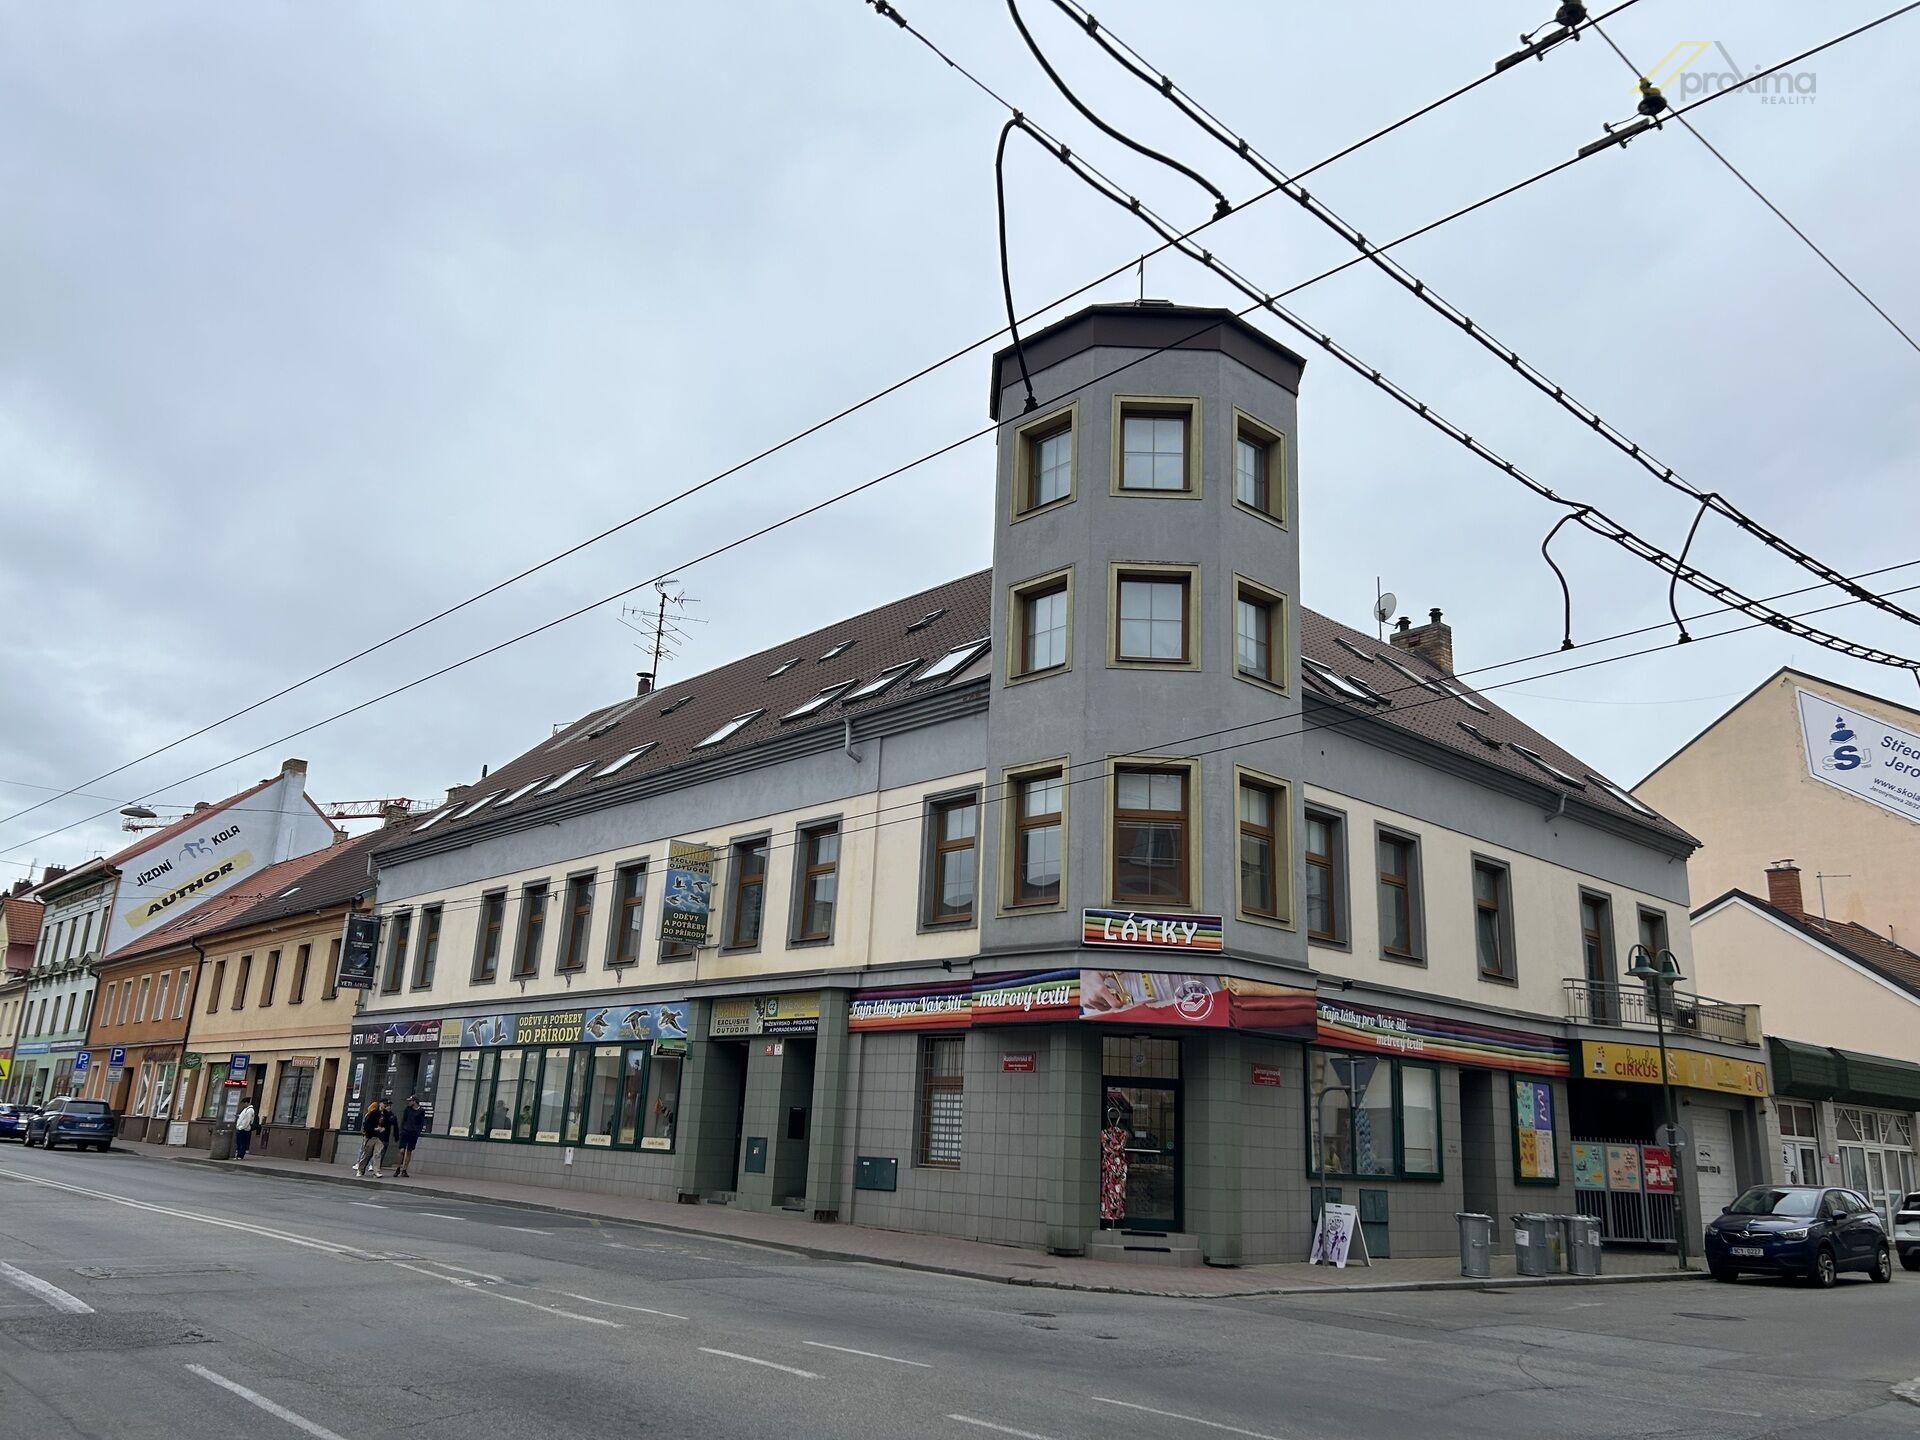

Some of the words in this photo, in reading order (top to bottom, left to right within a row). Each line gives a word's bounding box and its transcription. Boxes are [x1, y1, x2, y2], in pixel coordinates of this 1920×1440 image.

[137, 858, 173, 886] JÍZDNÍ
[212, 825, 240, 846] KOLA
[670, 857, 710, 868] EXCLUSIVE
[670, 863, 710, 874] OUTDOOR
[147, 862, 234, 916] AUTHOR
[673, 912, 699, 922] ODĚVY
[672, 920, 706, 930] POTŘEBY
[1104, 912, 1198, 944] LÁTKY
[676, 928, 706, 938] PŘÍRODY
[979, 987, 1034, 1012] metrový
[1036, 986, 1070, 1005] textil
[852, 1002, 872, 1020] Fajn
[873, 1000, 899, 1019] látky
[899, 1004, 916, 1018] pro
[920, 996, 945, 1012] Vaše
[945, 994, 962, 1012] šití
[520, 1014, 544, 1026] ODĚVY
[544, 1016, 548, 1024] A
[550, 1012, 583, 1024] POTŘEBY
[1322, 1006, 1340, 1024] Fajn
[1341, 1009, 1360, 1028] látky
[1361, 1015, 1376, 1028] pro
[1376, 1014, 1395, 1030] Vaše
[517, 1030, 532, 1044] DO
[534, 1024, 582, 1042] PŘÍRODY
[1406, 1038, 1424, 1050] textil
[78, 1054, 88, 1064] P
[113, 1050, 124, 1060] P
[1614, 1062, 1658, 1078] CIRKUS
